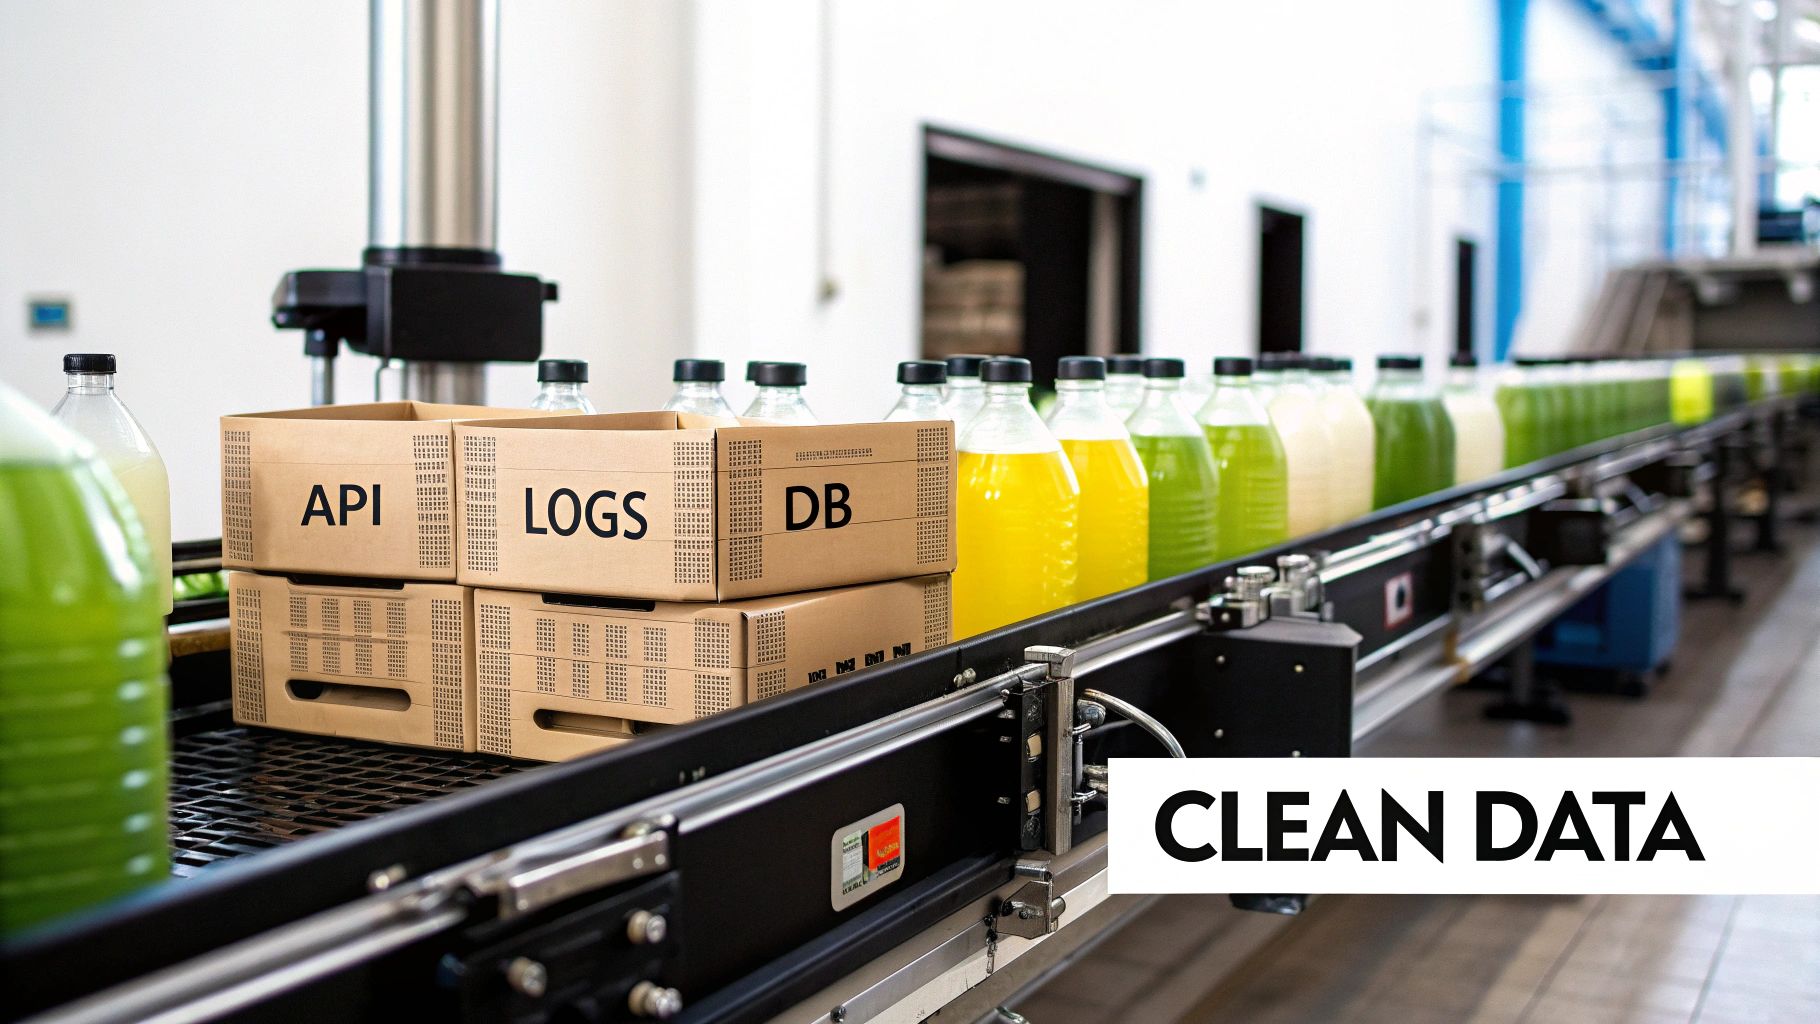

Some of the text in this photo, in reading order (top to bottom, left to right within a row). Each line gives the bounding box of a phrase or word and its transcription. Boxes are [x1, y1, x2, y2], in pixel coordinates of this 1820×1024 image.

[300, 484, 381, 527] API
[525, 487, 648, 541] LOGS
[785, 482, 853, 532] DB
